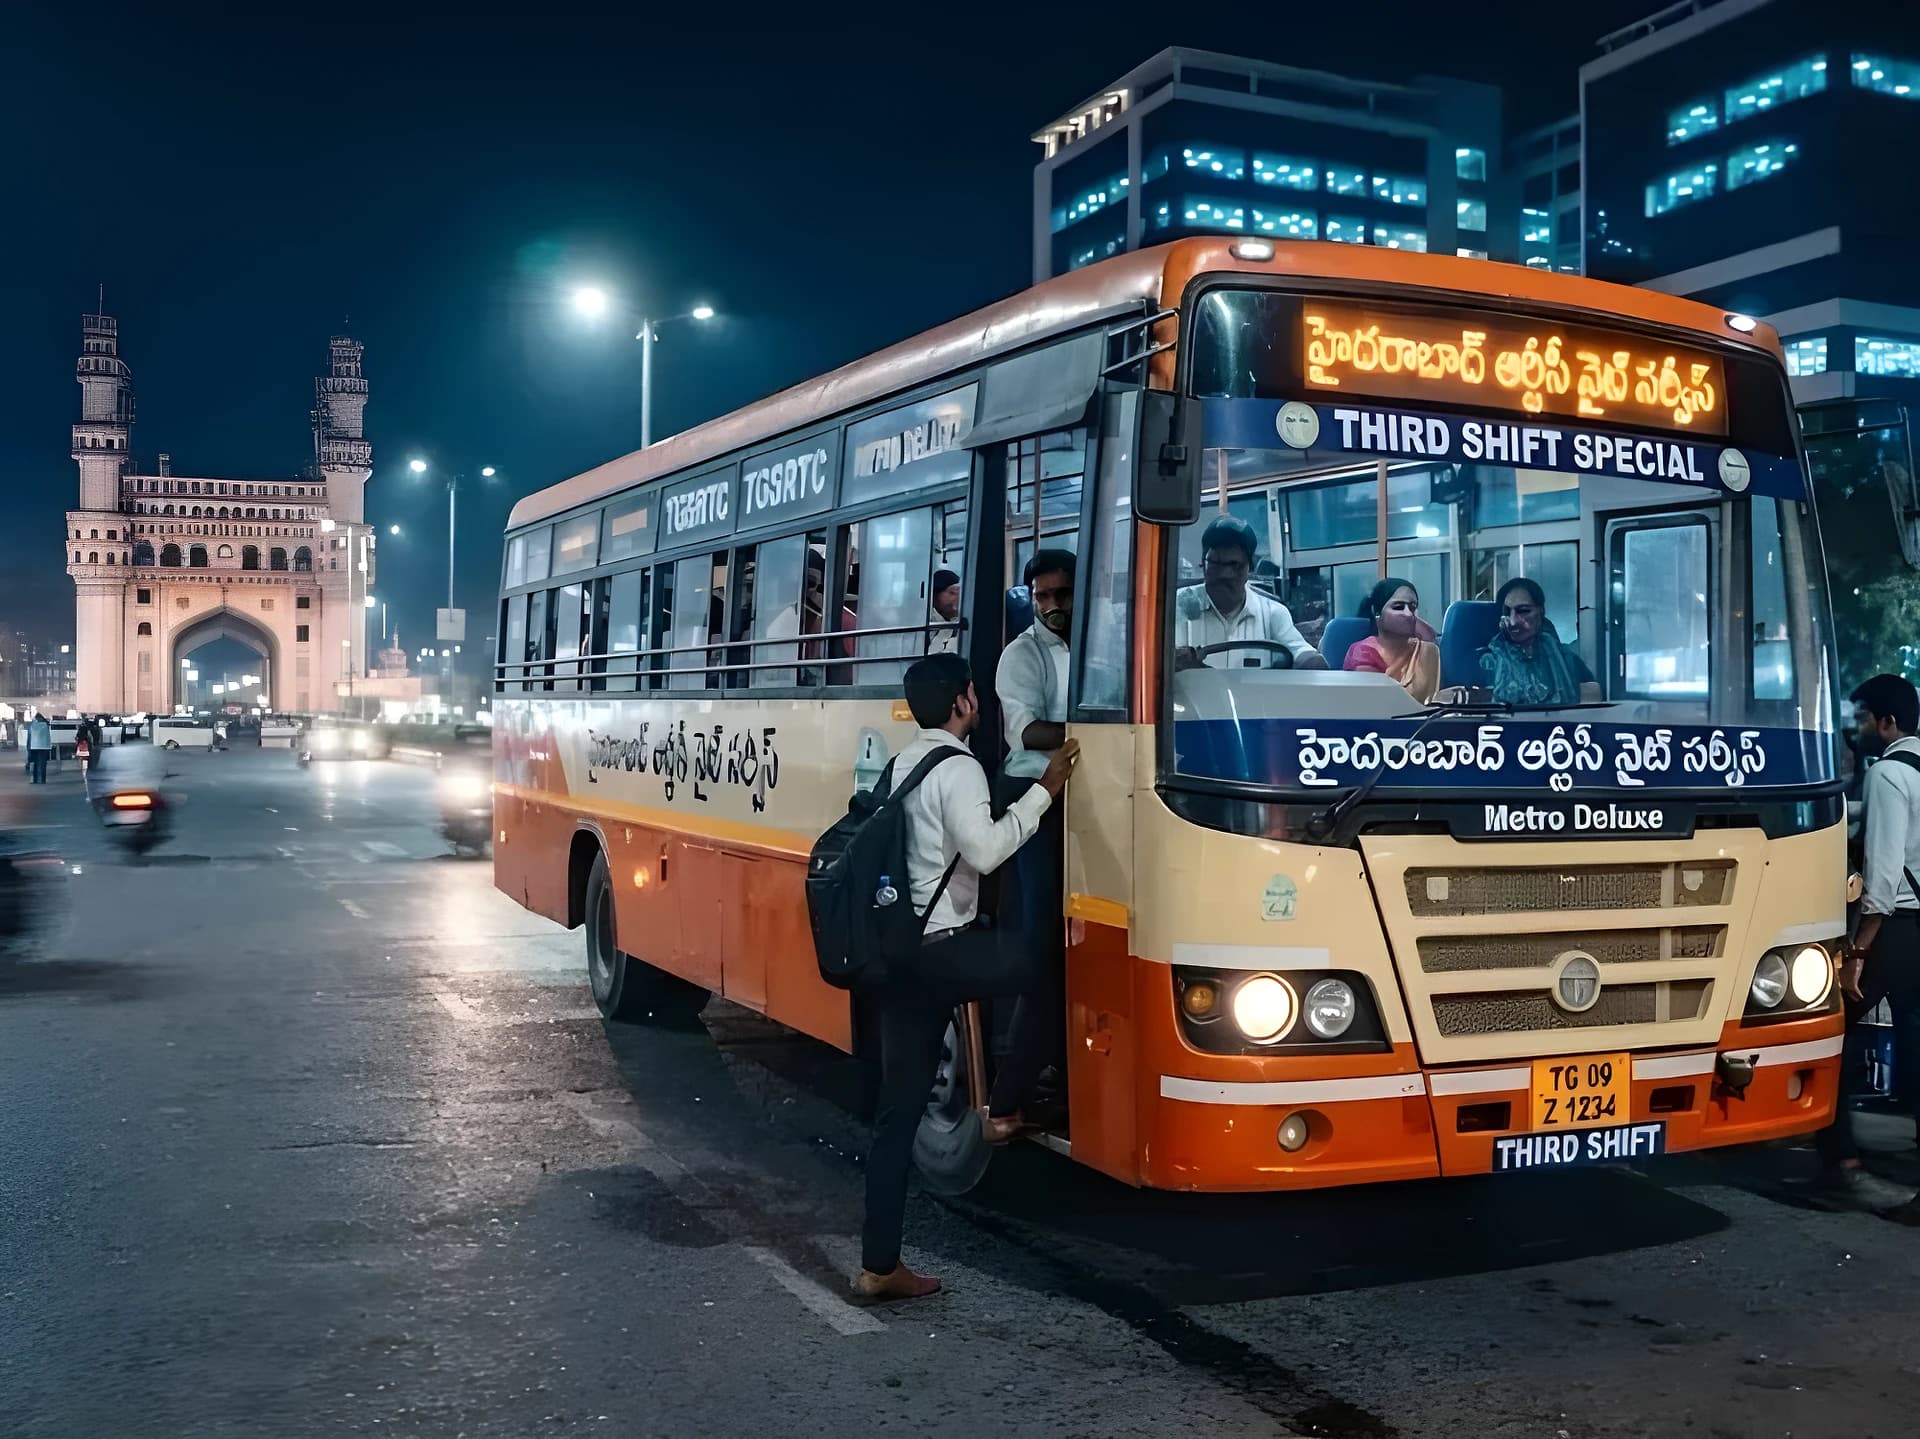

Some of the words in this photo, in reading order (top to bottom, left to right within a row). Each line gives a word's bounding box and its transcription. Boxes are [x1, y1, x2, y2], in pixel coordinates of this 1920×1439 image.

[1334, 408, 1451, 456] THIRD
[1461, 421, 1563, 467] SHIFT
[1573, 434, 1704, 482] SPECIAL
[1296, 725, 1505, 786] హైదరాబాద్
[1615, 729, 1673, 786] నైట్
[1484, 804, 1566, 832] Metro
[1574, 803, 1664, 830] Deluxe
[1549, 1065, 1578, 1091] TG
[1588, 1062, 1612, 1088] 09
[1543, 1098, 1558, 1124] Z
[1565, 1093, 1616, 1122] 1234
[1496, 1134, 1579, 1169] THIRD
[1587, 1123, 1661, 1160] SHIFT
